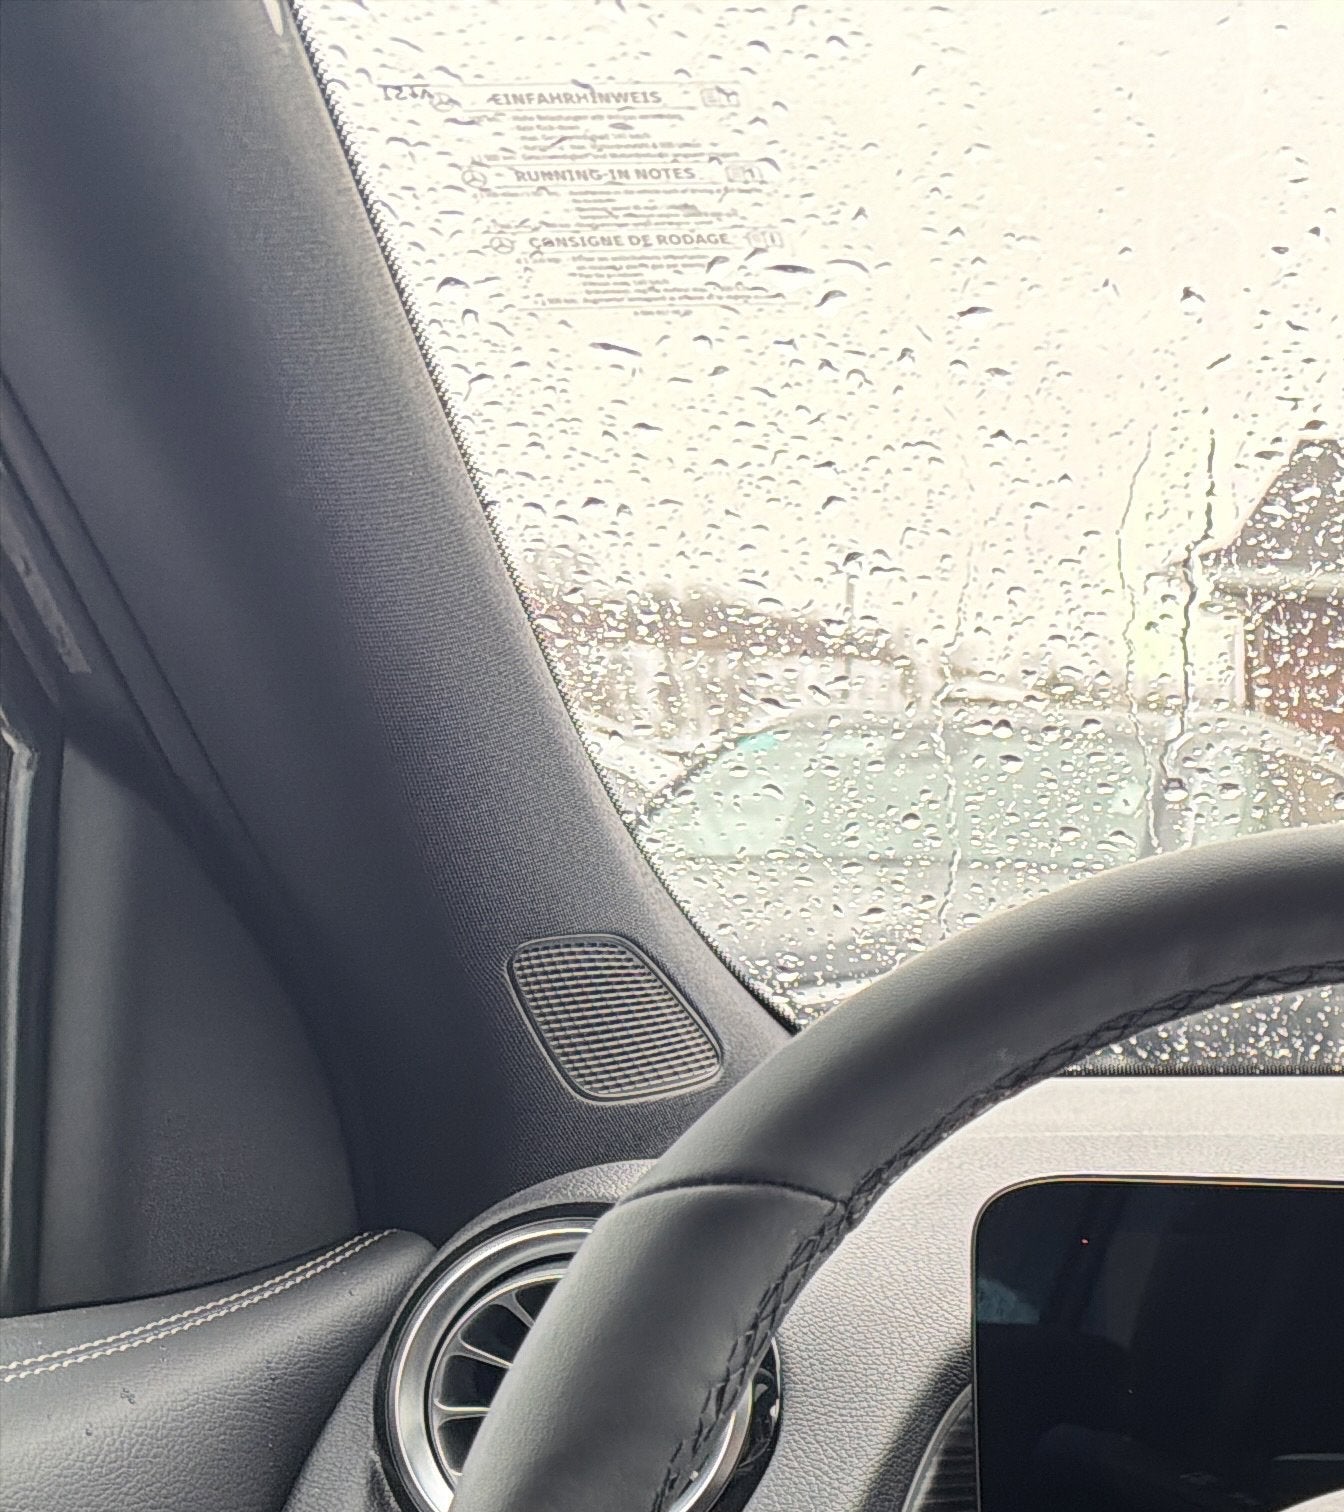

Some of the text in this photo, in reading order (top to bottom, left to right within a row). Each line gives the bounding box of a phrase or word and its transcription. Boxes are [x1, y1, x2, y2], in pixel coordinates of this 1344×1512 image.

[493, 91, 662, 105] EINFAHRHINWEIS
[515, 168, 696, 182] RUNNING-IN NOTES
[529, 233, 731, 248] CONSIGNE DE RODAGE
